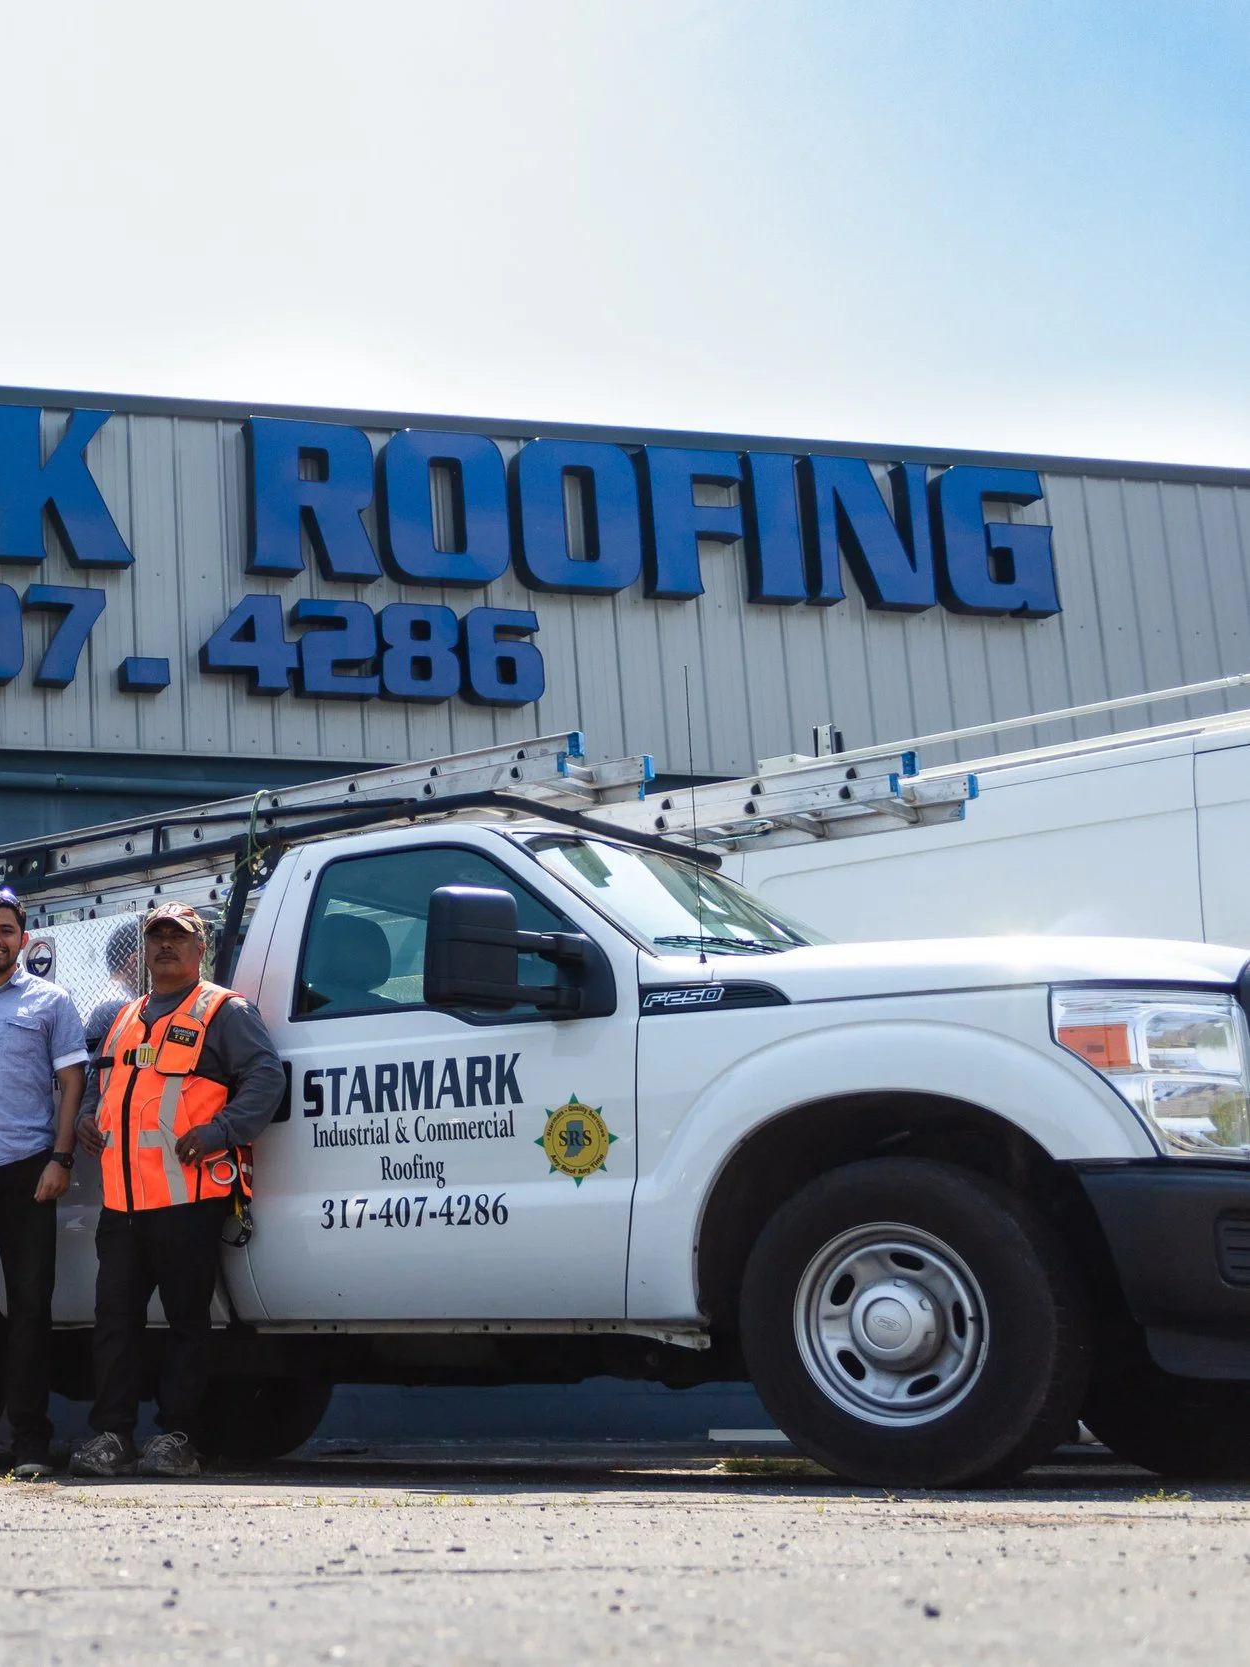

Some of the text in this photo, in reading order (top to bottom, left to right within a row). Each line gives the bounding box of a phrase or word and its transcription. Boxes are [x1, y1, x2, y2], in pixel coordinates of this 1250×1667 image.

[244, 415, 1062, 618] ROOFING
[303, 1052, 524, 1118] STARMARK
[312, 1110, 516, 1149] Industrial & Commercial
[558, 1130, 593, 1147] SRS
[380, 1154, 446, 1189] Roofing
[320, 1193, 510, 1230] 317-407-4286
